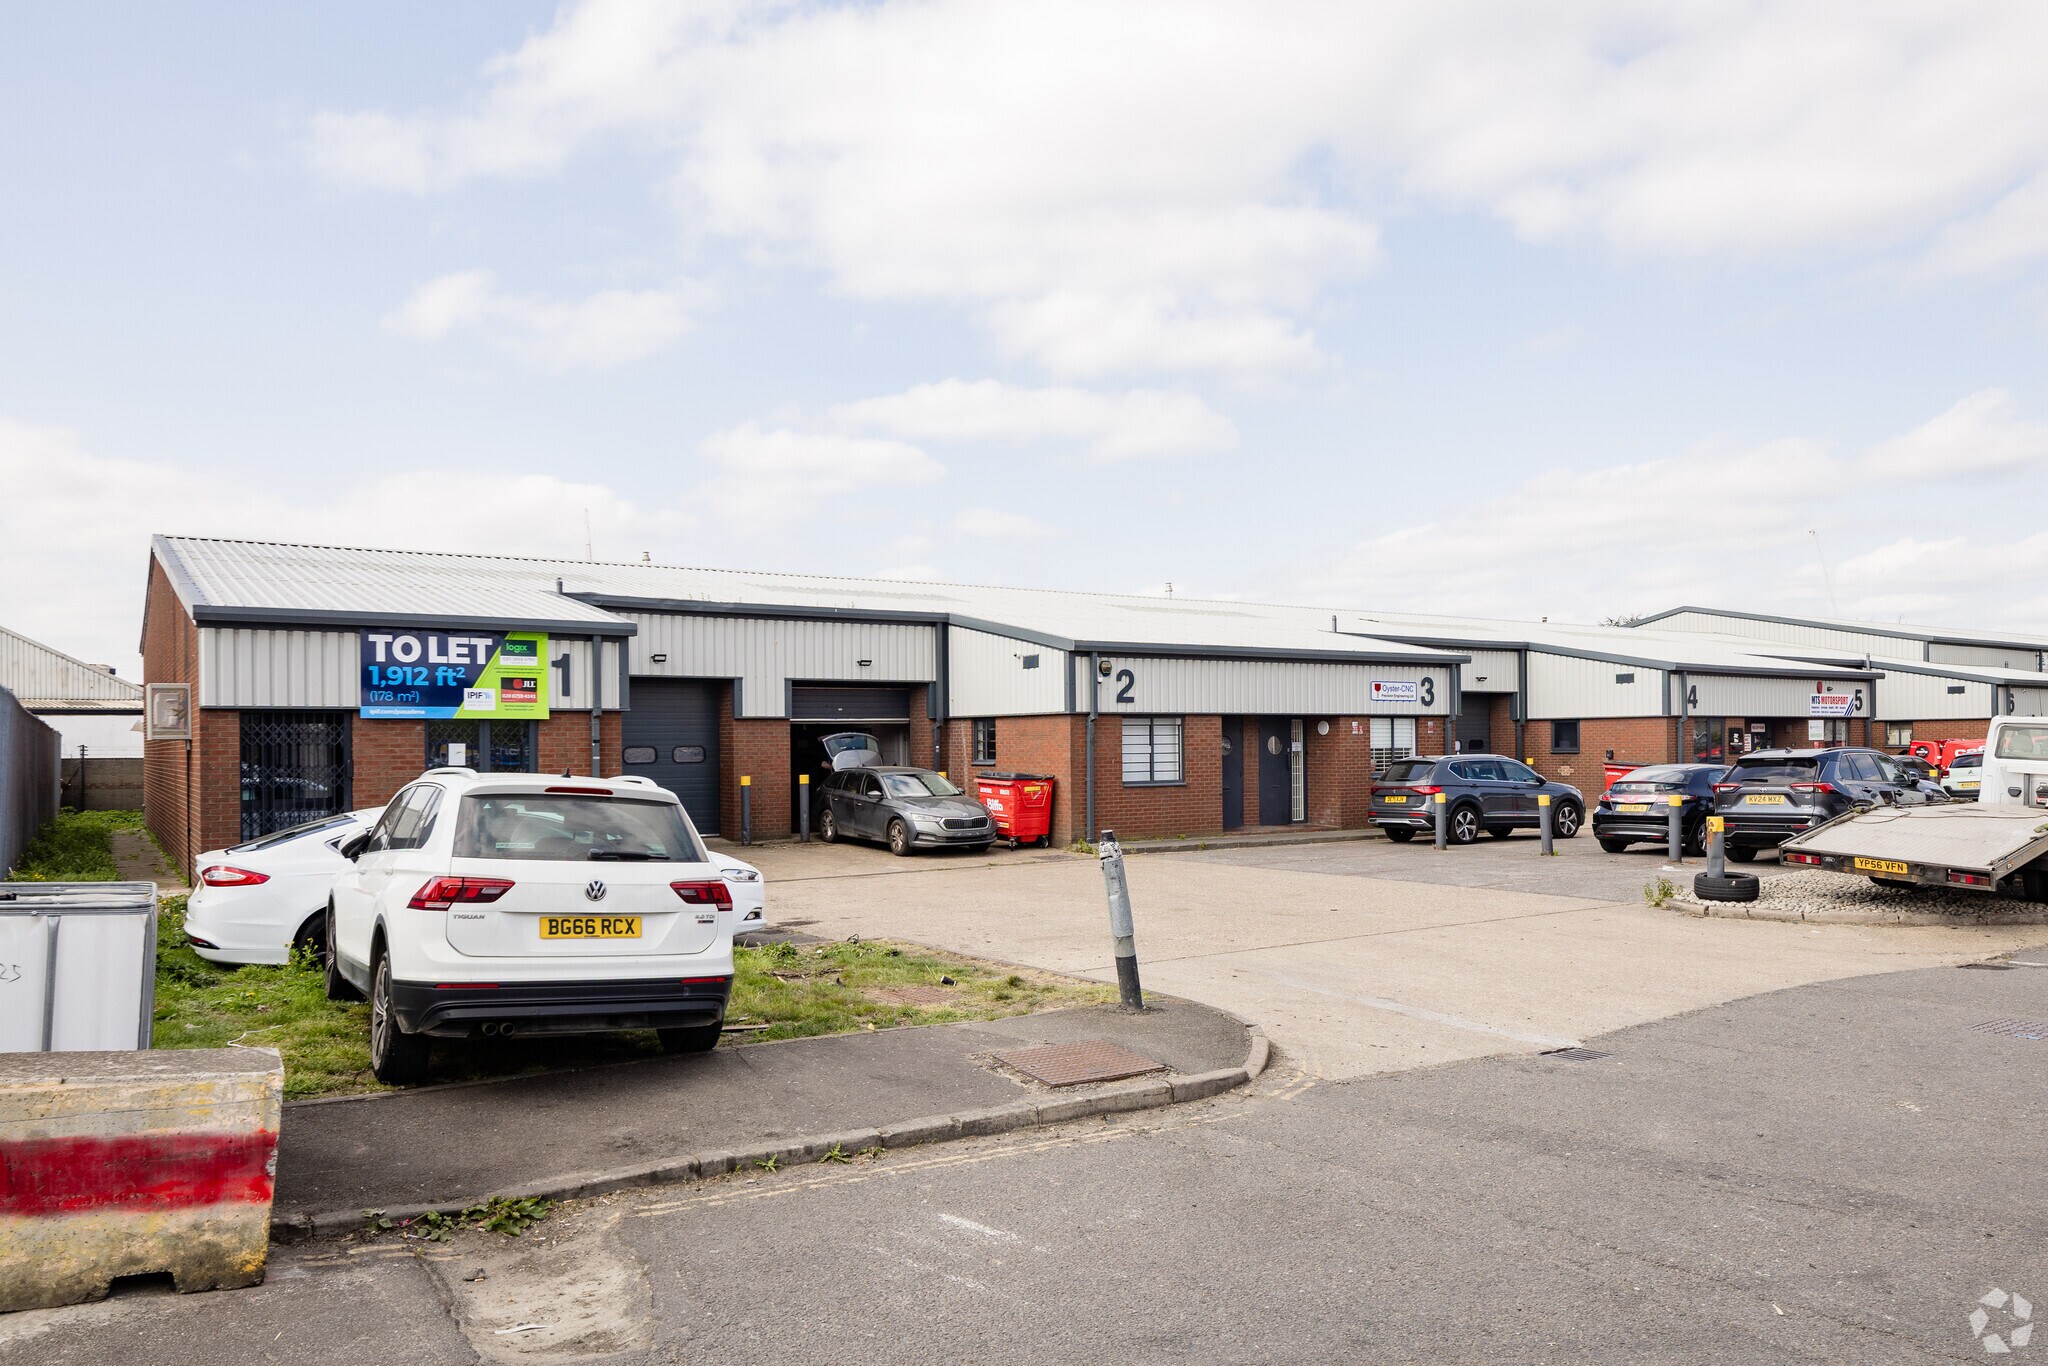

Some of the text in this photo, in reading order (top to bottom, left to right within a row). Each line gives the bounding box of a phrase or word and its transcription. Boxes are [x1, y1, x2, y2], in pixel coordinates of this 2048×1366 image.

[368, 634, 493, 665] TO LET
[506, 643, 527, 653] logix
[368, 665, 430, 688] 1,912
[552, 653, 570, 697] 1
[1116, 669, 1135, 703] 2
[1382, 684, 1414, 693] Oyster-CNC
[1420, 677, 1434, 706] 3
[369, 690, 394, 703] (178
[1688, 685, 1698, 709] 4
[1811, 695, 1848, 704] MTS MOTORSPORT
[1855, 689, 1863, 711] 5
[987, 798, 1003, 811] Biffa
[1748, 795, 1782, 803] KV24 MXZ
[1859, 859, 1904, 872] YP56 VFN
[548, 917, 635, 935] BG66 RCX
